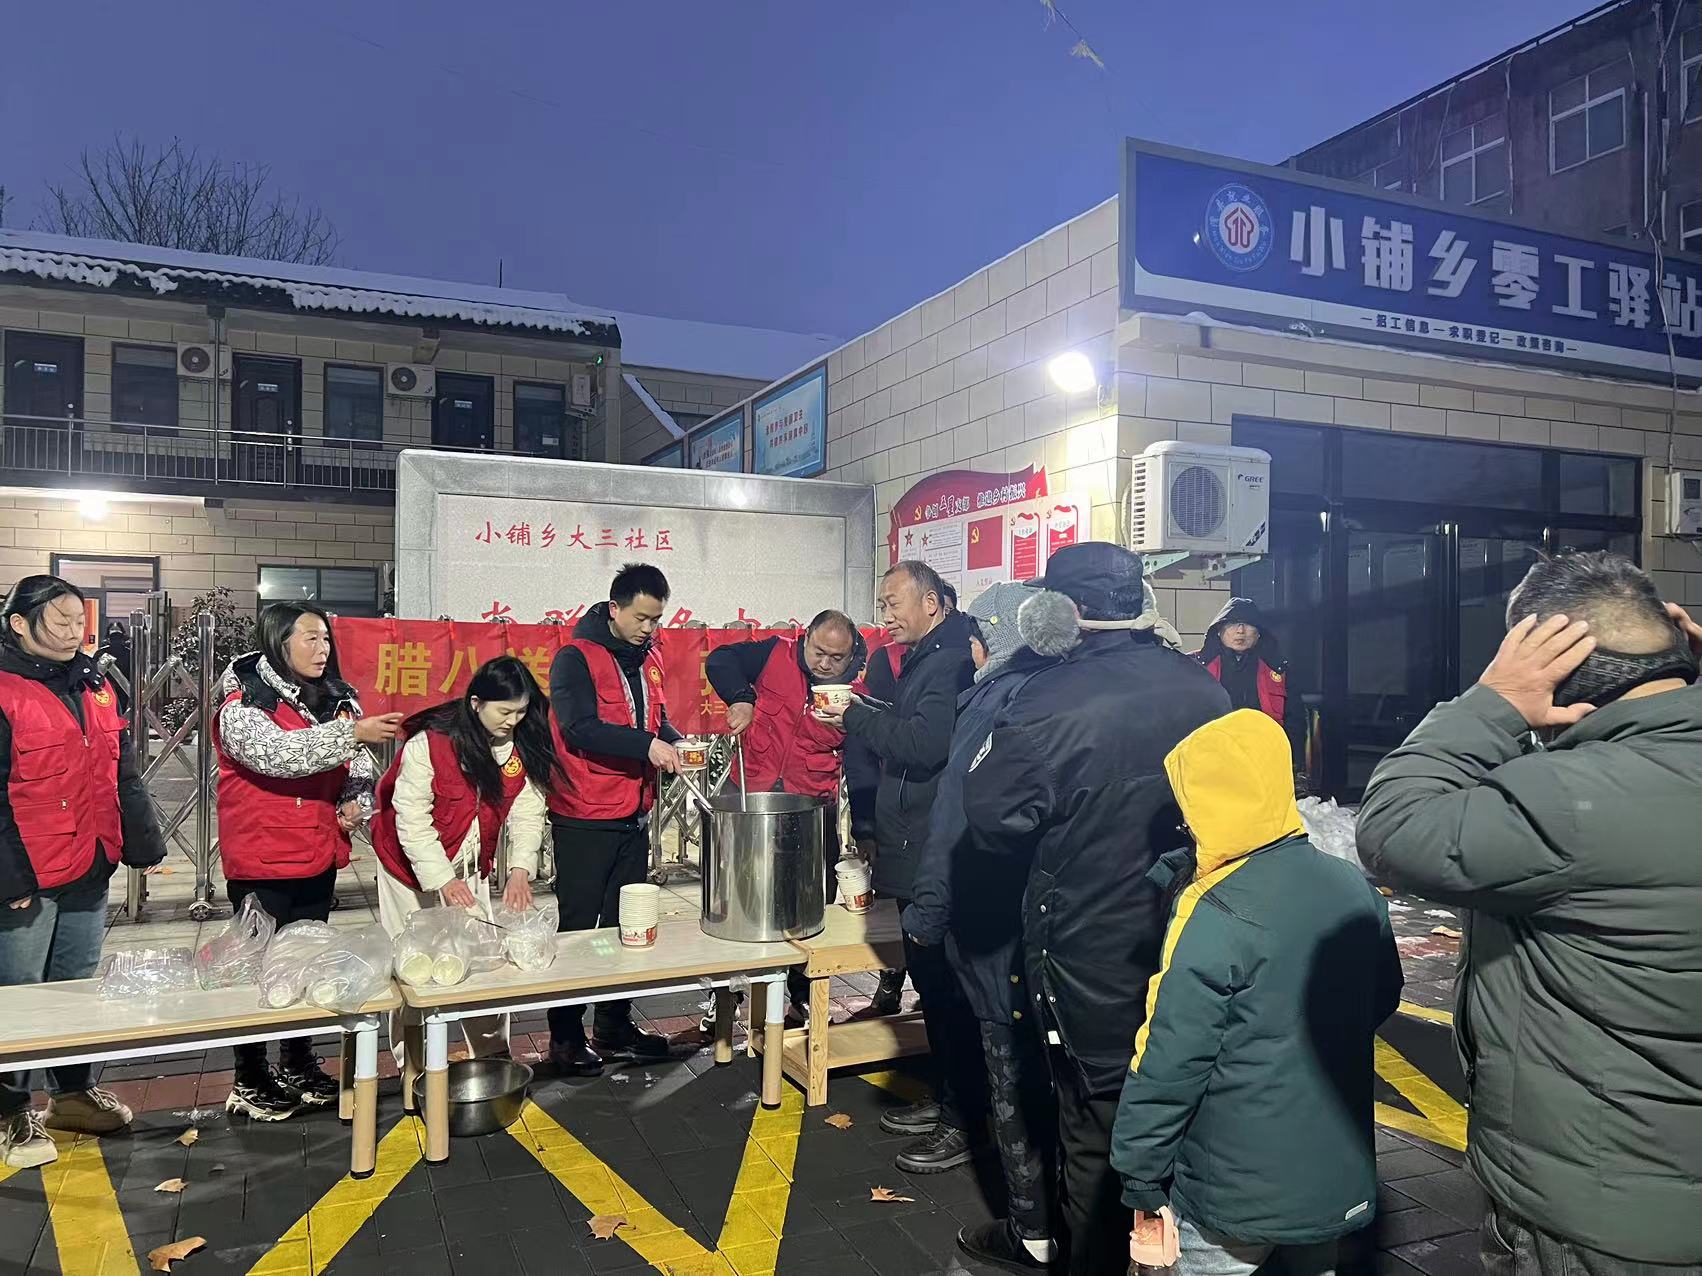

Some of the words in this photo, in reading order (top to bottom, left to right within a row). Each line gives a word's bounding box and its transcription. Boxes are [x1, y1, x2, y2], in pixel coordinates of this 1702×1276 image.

[1290, 205, 1702, 338] 小铺乡零工驿站
[1244, 475, 1264, 483] GREE
[474, 521, 674, 551] 小铺乡大三社区
